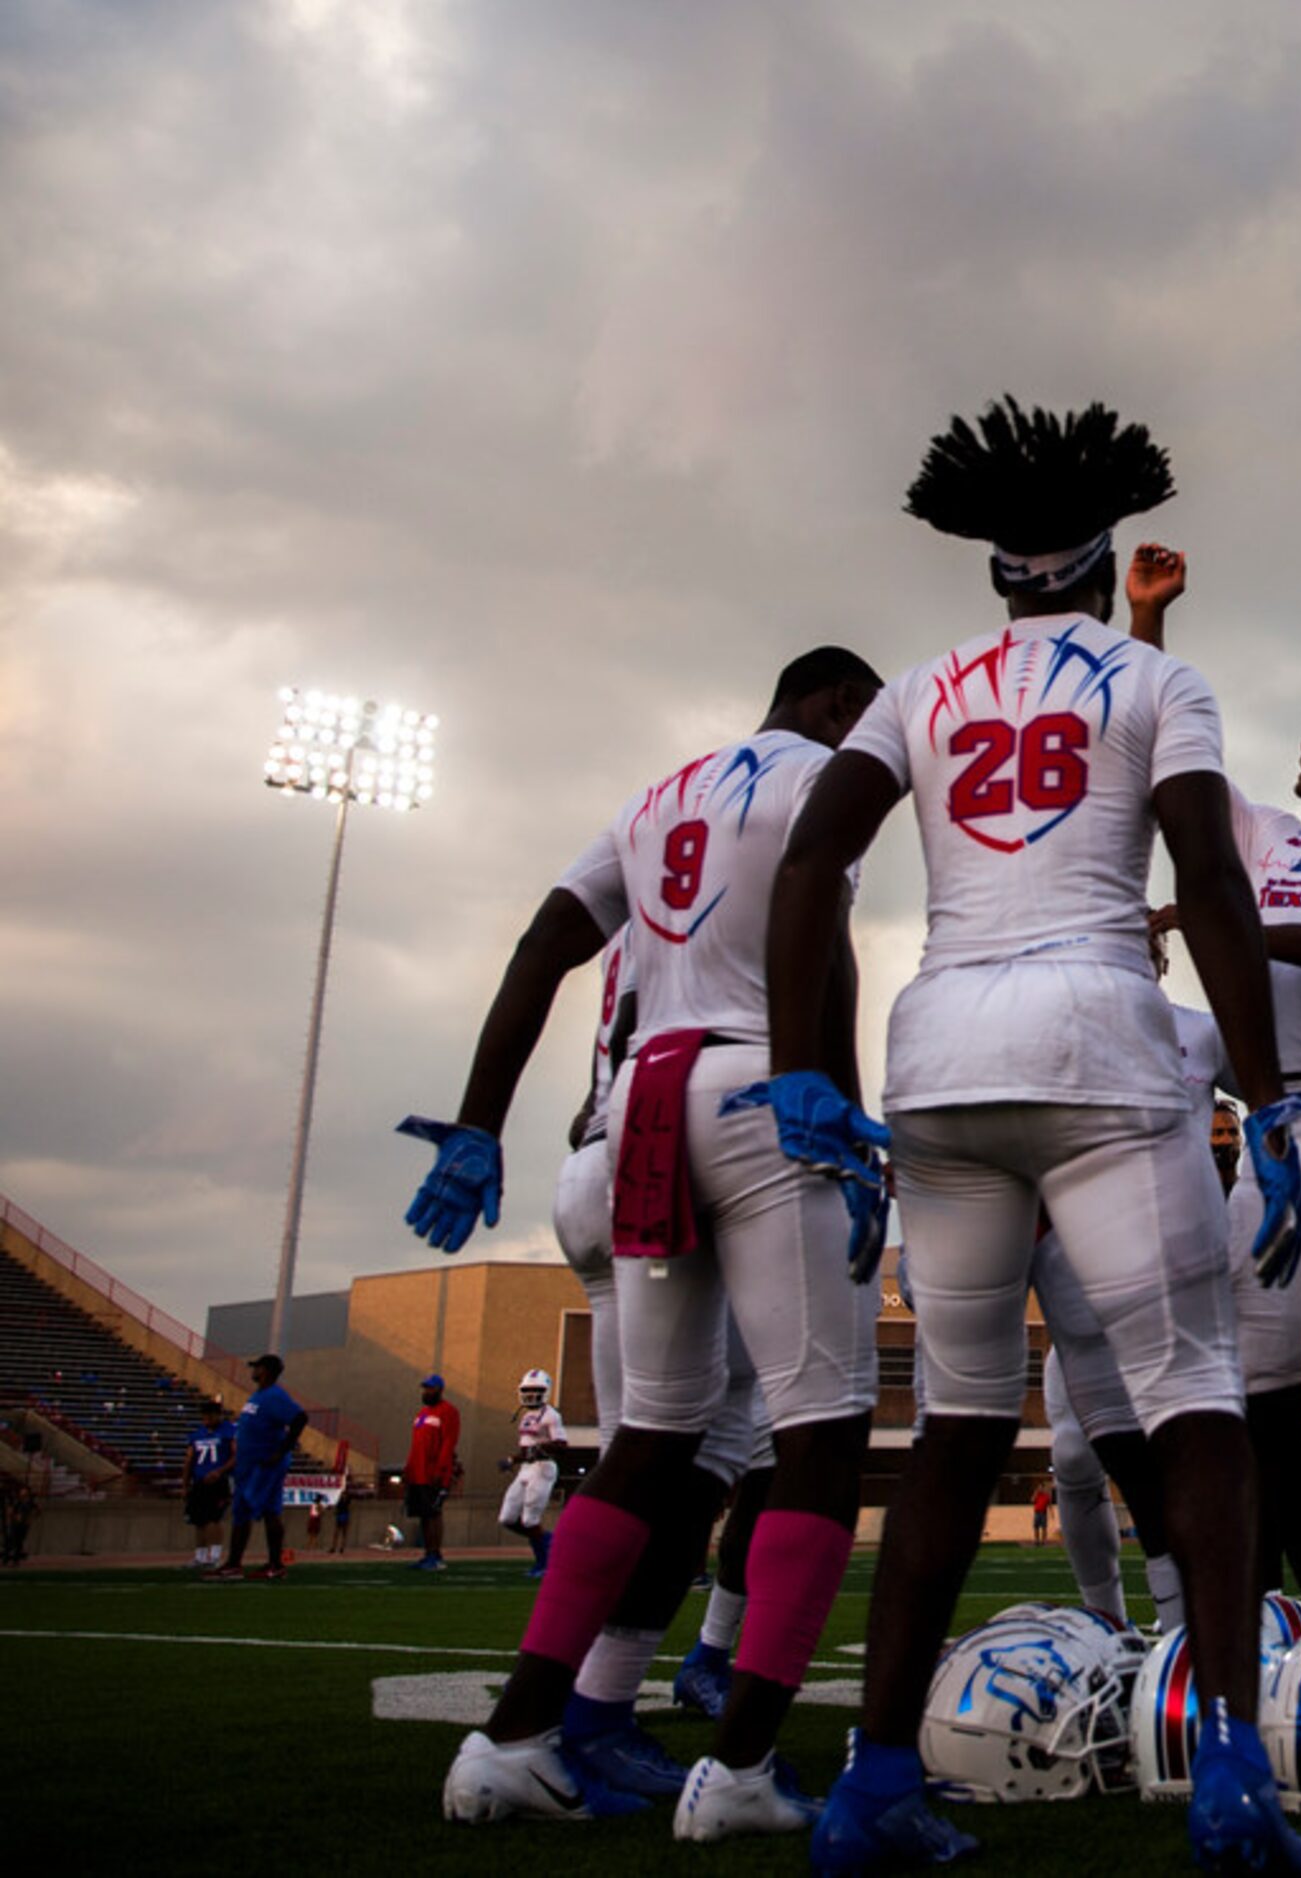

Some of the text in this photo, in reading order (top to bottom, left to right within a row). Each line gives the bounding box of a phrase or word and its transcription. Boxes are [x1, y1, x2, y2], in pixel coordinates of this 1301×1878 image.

[949, 711, 1089, 822] 26
[660, 818, 709, 911] 9
[194, 1445, 219, 1465] 71
